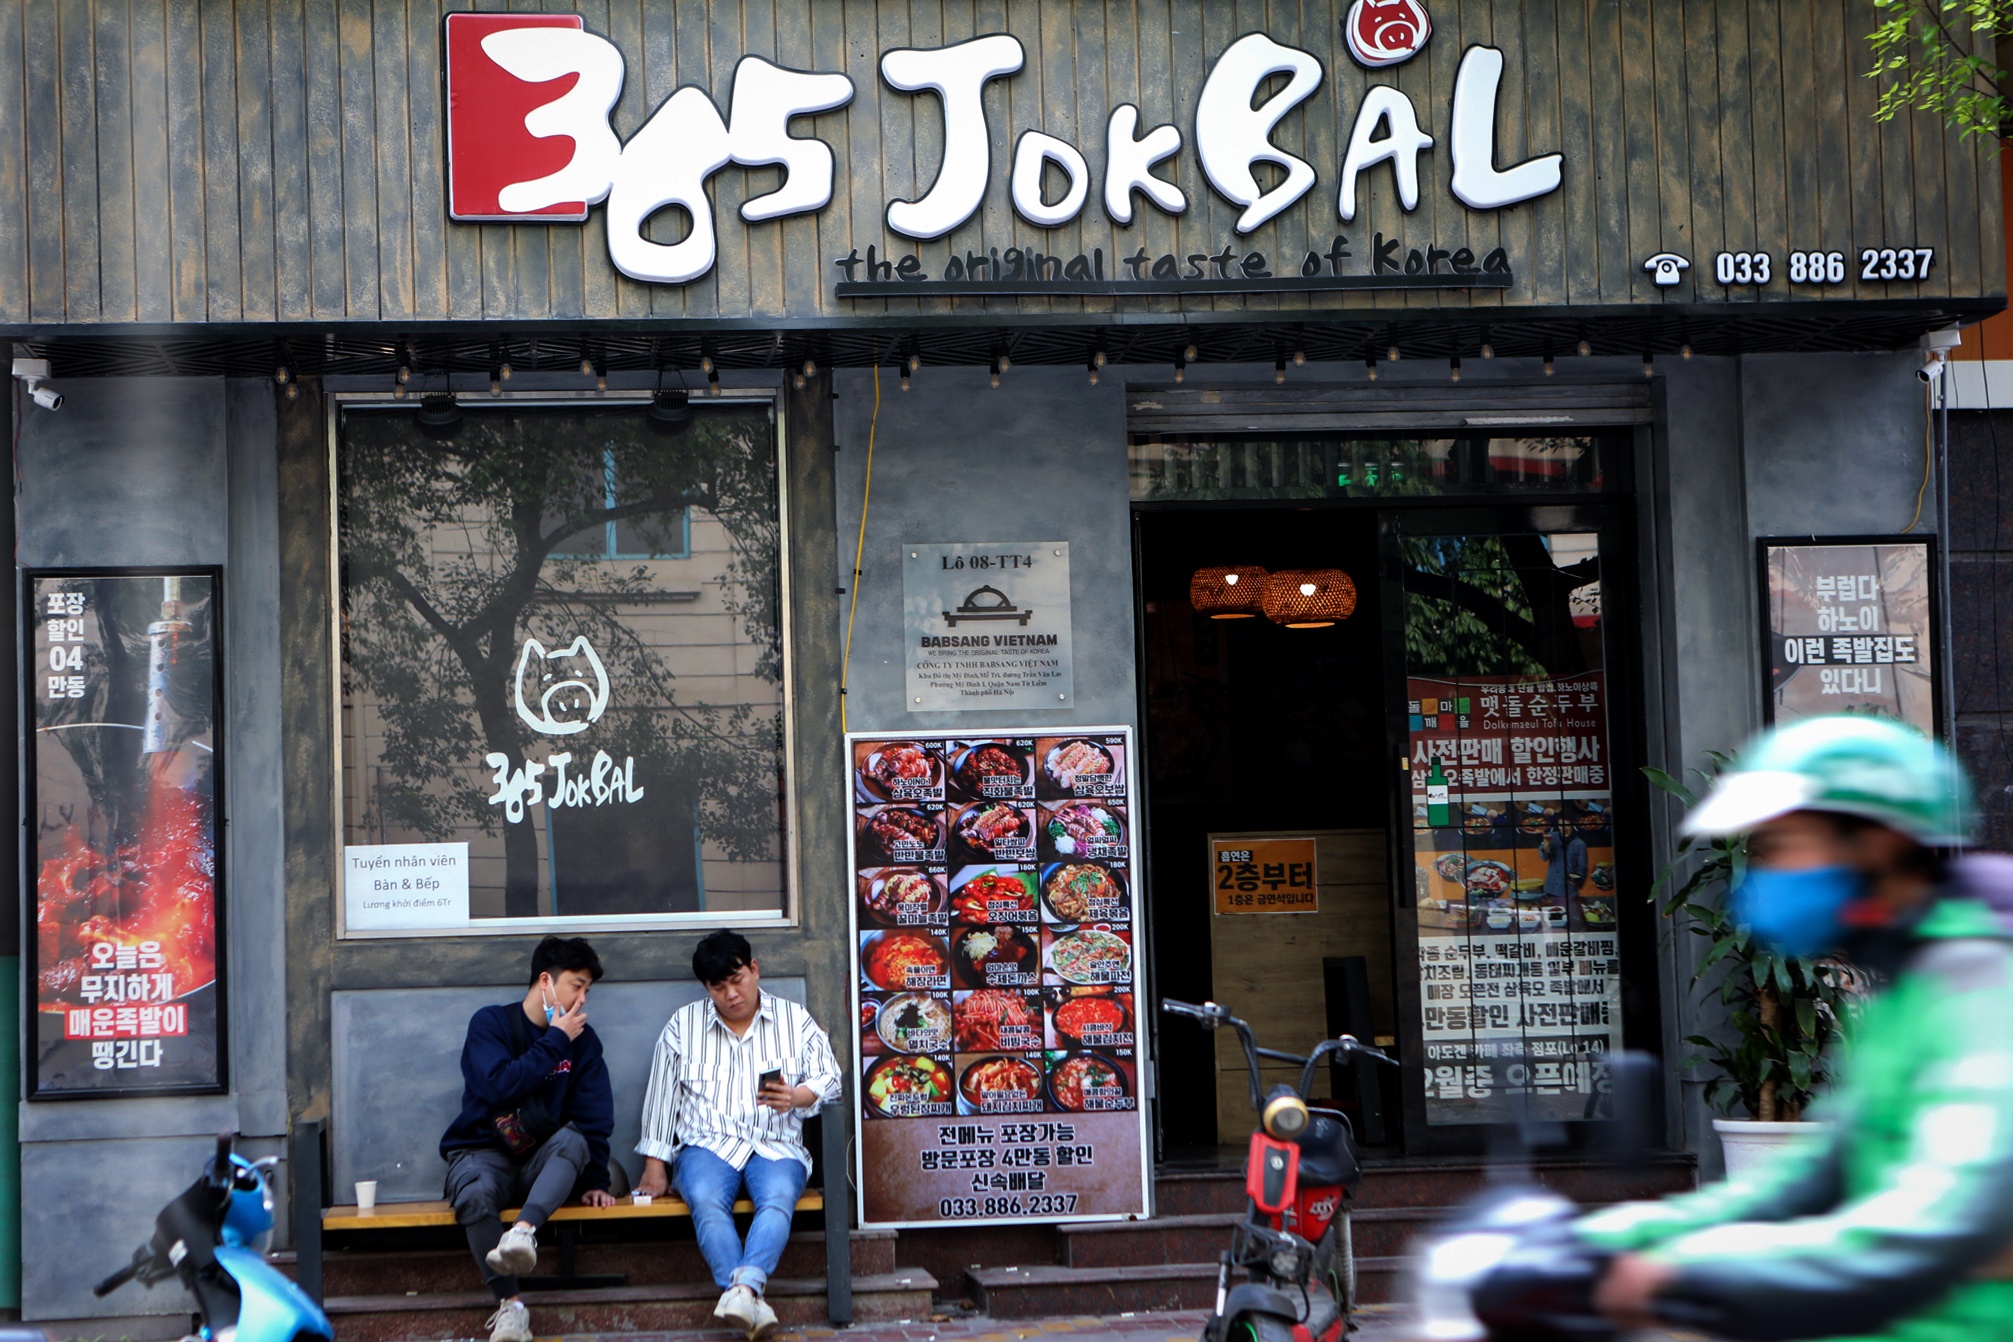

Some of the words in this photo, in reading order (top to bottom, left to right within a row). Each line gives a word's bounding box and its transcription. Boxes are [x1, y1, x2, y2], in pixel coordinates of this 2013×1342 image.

[836, 244, 928, 282] the
[944, 244, 1104, 282] original
[1124, 245, 1273, 280] taste
[1300, 235, 1352, 278] of
[1716, 251, 1771, 284] 033
[1789, 251, 1846, 284] 886
[1861, 248, 1934, 281] 2337
[942, 555, 964, 570] Lô
[970, 554, 1032, 570] 08-TT4
[1816, 575, 1879, 602] 부럽다
[47, 592, 85, 615] 포장
[1817, 605, 1879, 633] 하노이
[47, 619, 84, 642] 할인
[921, 635, 990, 647] BABSANG
[993, 634, 1057, 646] VIETNAM
[1784, 638, 1826, 665] 이런
[1832, 637, 1916, 664] 족발집도
[49, 646, 83, 671] 04
[917, 660, 940, 669] CÔNG
[943, 661, 954, 669] TY
[955, 661, 978, 669] TNHH
[980, 660, 1018, 668] BABSANG
[1019, 659, 1038, 669] VIỆT
[48, 675, 86, 699] 만동
[1820, 668, 1882, 695] 있다니
[1440, 700, 1453, 713] 마
[1483, 719, 1539, 730] Dolkemaeul
[1542, 718, 1563, 728] Tofu
[1566, 718, 1597, 728] House
[1016, 739, 1034, 747] 620K
[1413, 738, 1503, 766] 사전판매
[1510, 735, 1601, 764] 할인행사
[983, 776, 1022, 785] 불맛터지는
[1074, 774, 1112, 783] 정말담백한
[1411, 769, 1522, 789] 삼오족발에서
[1526, 765, 1605, 786] 한정판매중
[892, 788, 943, 799] 삼육오족발
[983, 786, 1035, 798] 직화불족발
[1075, 785, 1125, 796] 삼육오보쌈
[994, 837, 1026, 846] 일타쌍피
[893, 849, 945, 862] 반반불족발
[995, 848, 1036, 859] 반반보쌈
[1087, 846, 1128, 859] 냉채족발
[1220, 850, 1251, 862] 흡연은
[352, 854, 391, 871] Tuyển
[394, 854, 427, 868] nhân
[429, 854, 457, 867] viên
[1218, 862, 1313, 892] 2층부터
[374, 876, 398, 891] Bàn
[401, 878, 412, 890] &
[416, 875, 440, 893] Bếp
[363, 899, 391, 911] Lương
[413, 897, 436, 908] điểm
[437, 898, 451, 907] 6Tr
[987, 900, 1019, 910] 점심특선
[1088, 897, 1120, 906] 점심특선
[1228, 895, 1253, 906] 1층은
[1257, 894, 1315, 905] 금연석입니다
[897, 913, 949, 925] 꿀마늘족발
[987, 910, 1039, 922] 오징어볶음
[1089, 908, 1130, 920] 제육볶음
[92, 941, 162, 969] 오늘은
[905, 965, 937, 974] 속풀이엔
[986, 963, 1018, 973] 엄마손맛
[1089, 960, 1120, 968] 술안주엔
[906, 976, 947, 987] 해장라면
[987, 973, 1039, 985] 수제돈까스
[1090, 970, 1132, 982] 해물파전
[81, 973, 173, 1004] 무지하게
[1427, 984, 1455, 1000] 매장
[69, 1006, 184, 1036] 매운족발이
[907, 1028, 939, 1037] 바다의맛
[1082, 1033, 1134, 1045] 해물김치전
[908, 1038, 950, 1050] 멸치국수
[1000, 1035, 1042, 1047] 비빔국수
[92, 1040, 163, 1070] 땡긴다
[981, 1090, 1027, 1100] 말이필요없는
[890, 1102, 951, 1115] 우렁된장찌개
[981, 1099, 1043, 1113] 돼지김치찌개
[1084, 1096, 1135, 1109] 해물순두부
[938, 1124, 995, 1146] 전메뉴
[1000, 1122, 1075, 1144] 포장가능
[921, 1149, 996, 1170] 방문포장
[1001, 1147, 1051, 1168] 4만동
[1055, 1144, 1093, 1166] 할인
[971, 1171, 1046, 1193] 신속배달
[940, 1194, 1078, 1217] 033.886.2337
